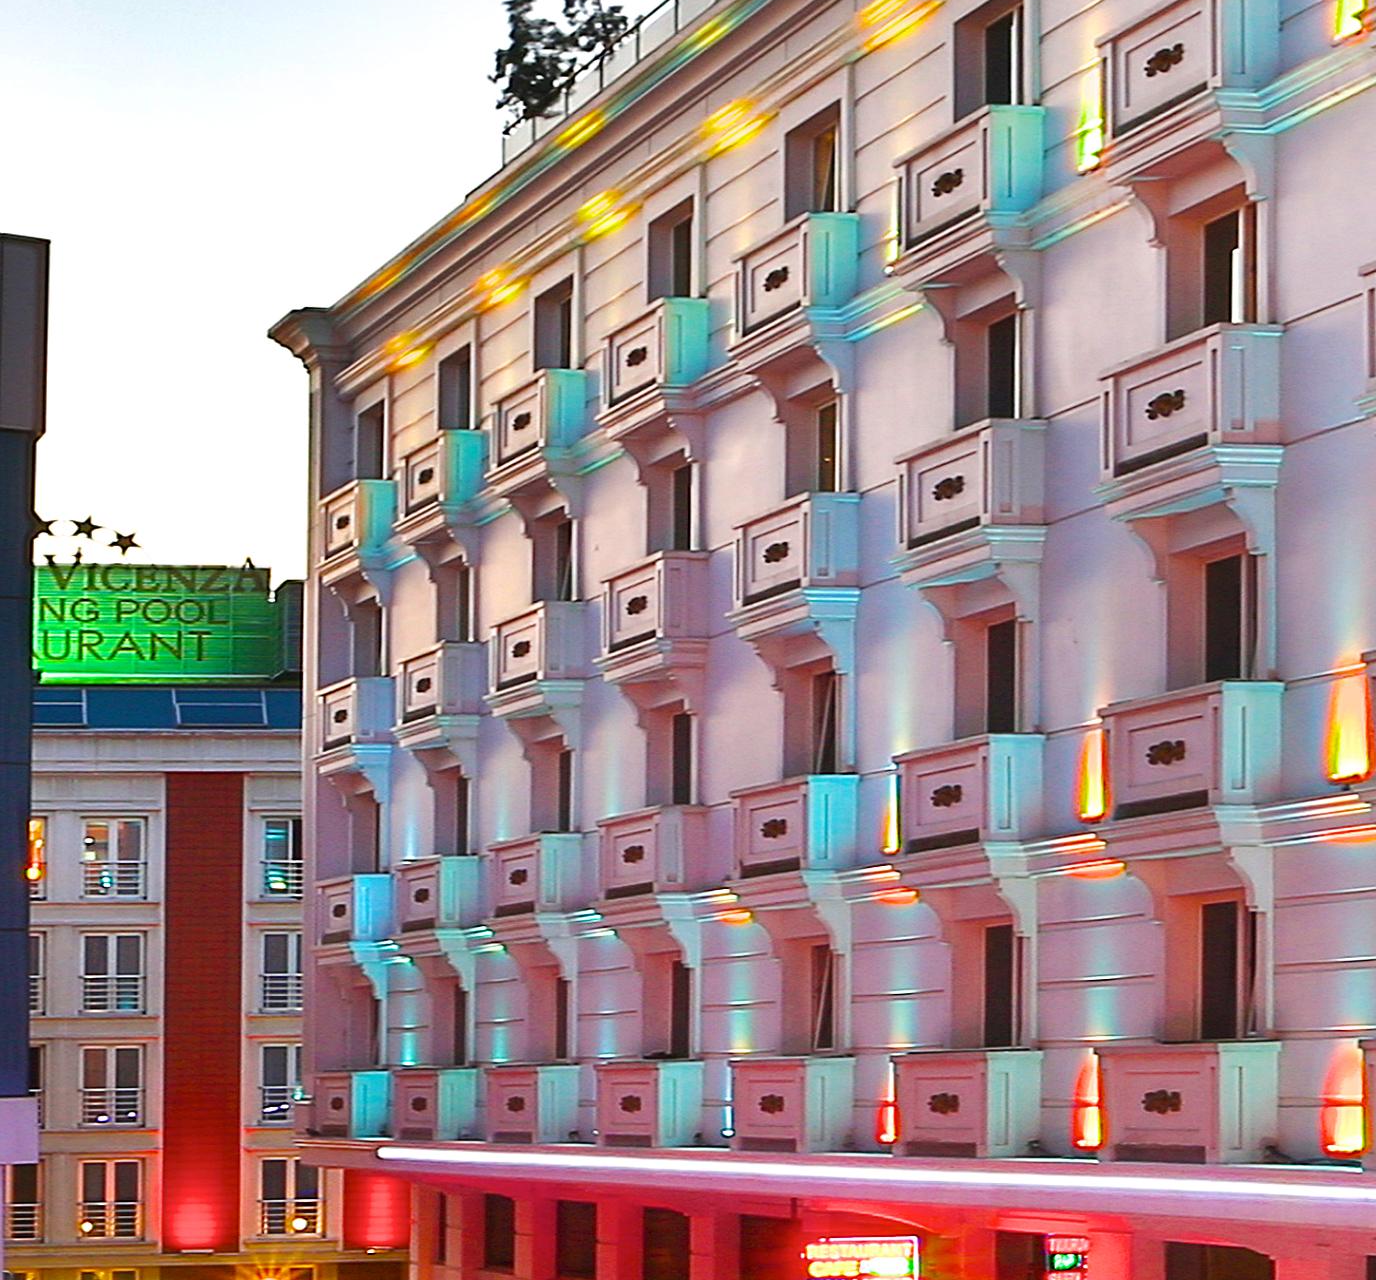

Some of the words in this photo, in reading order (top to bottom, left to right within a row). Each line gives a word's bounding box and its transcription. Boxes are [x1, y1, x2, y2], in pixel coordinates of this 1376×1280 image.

[43, 550, 266, 593] VICENZA
[116, 598, 230, 625] POOL
[33, 630, 213, 661] URANT
